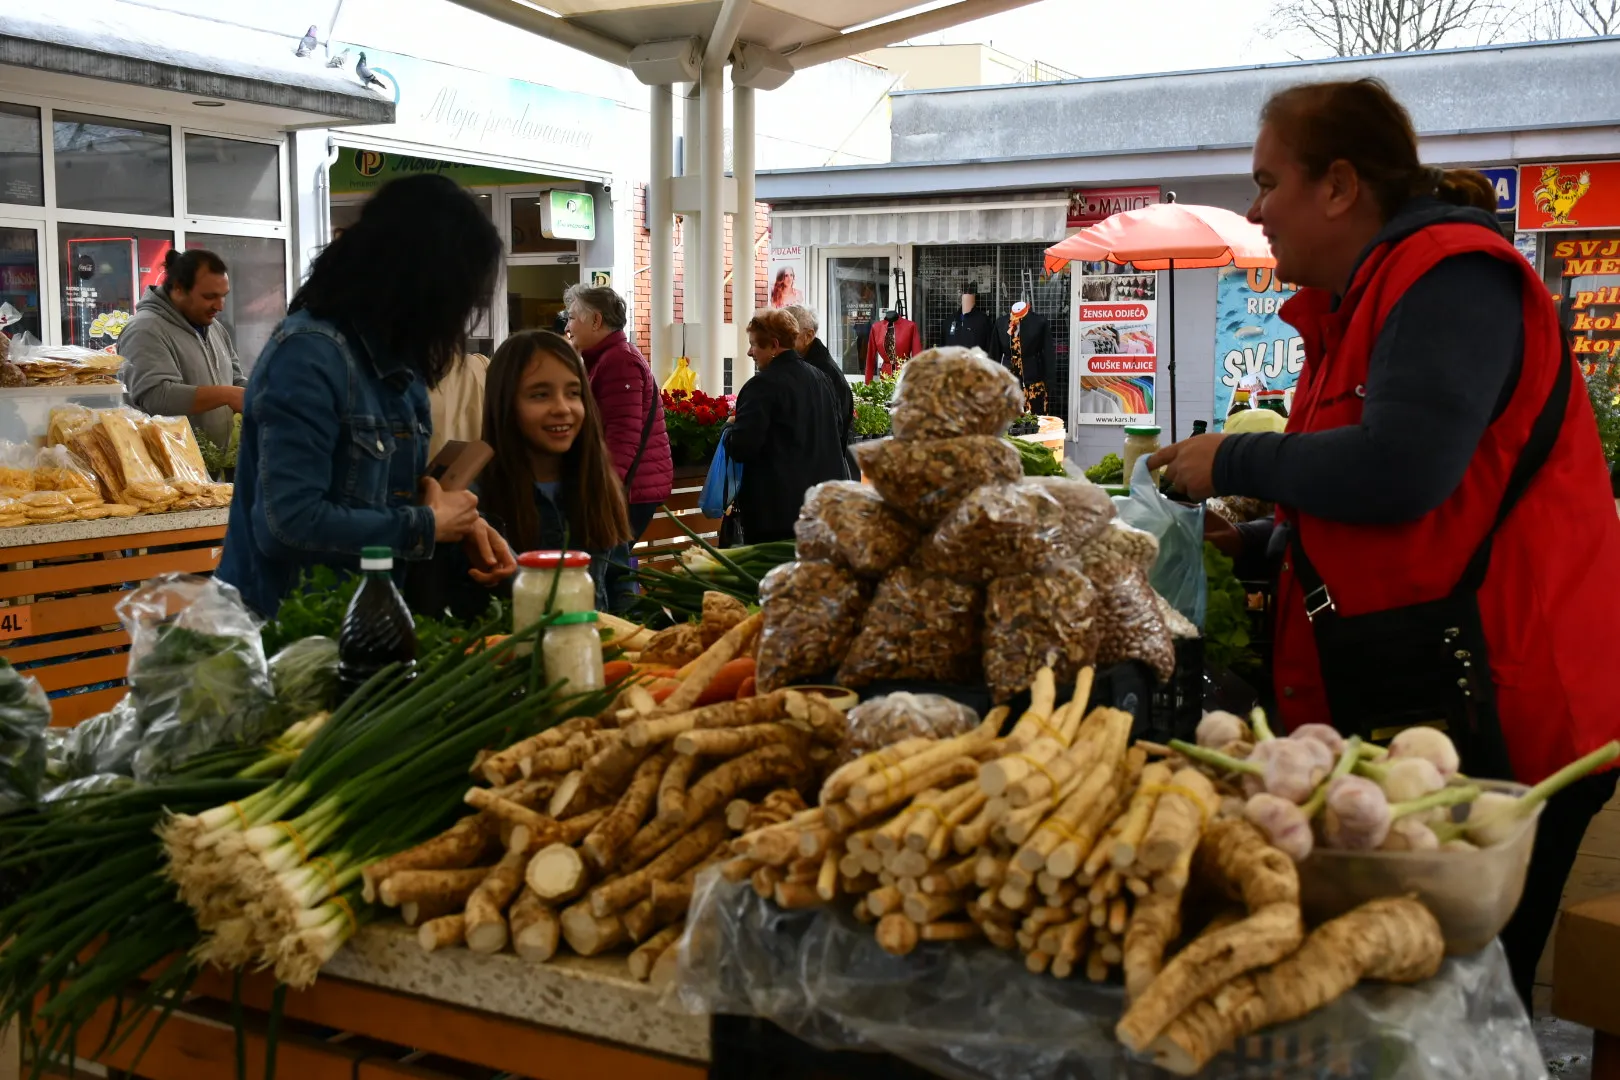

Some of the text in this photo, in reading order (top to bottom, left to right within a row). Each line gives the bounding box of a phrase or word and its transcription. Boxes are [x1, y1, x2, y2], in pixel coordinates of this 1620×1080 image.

[420, 86, 480, 141] Moja
[1083, 307, 1146, 318] ŽENSKA ODJEĆA
[1091, 360, 1153, 370] MUŠKE MAJICE
